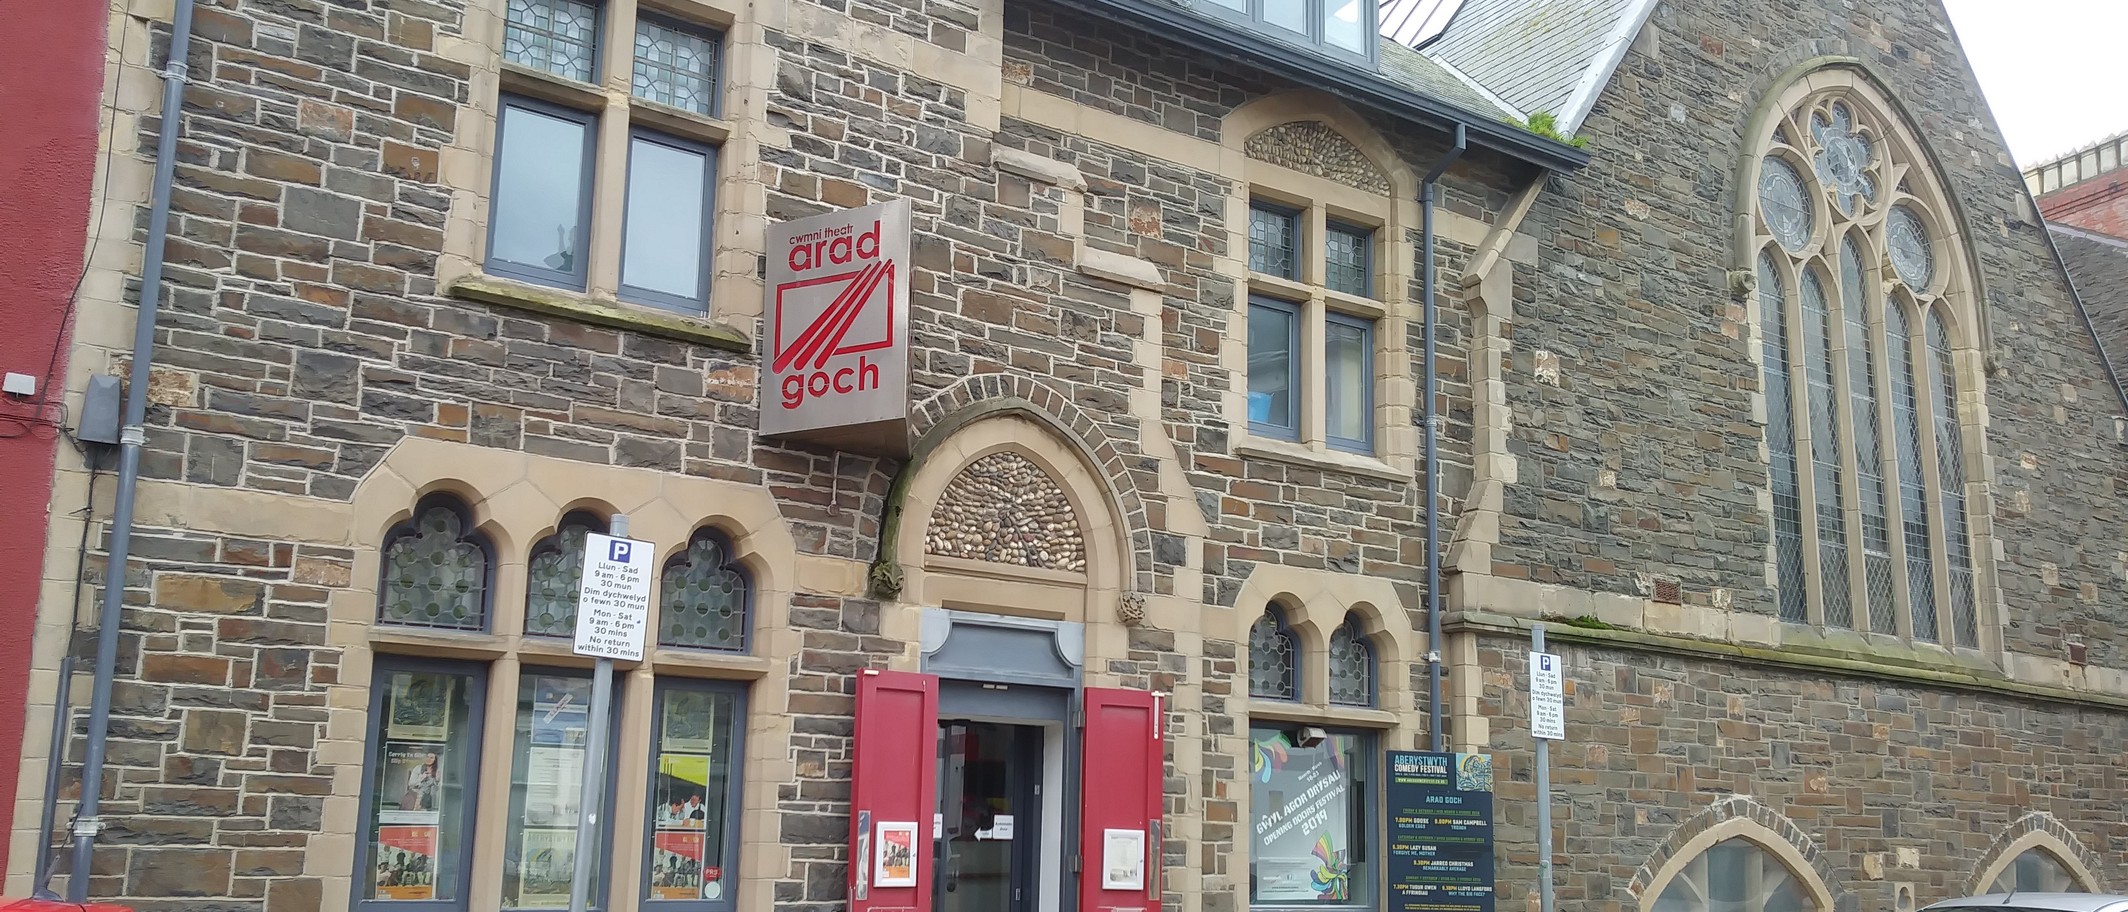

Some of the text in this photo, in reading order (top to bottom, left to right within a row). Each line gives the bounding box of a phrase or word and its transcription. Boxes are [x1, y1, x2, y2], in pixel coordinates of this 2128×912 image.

[789, 223, 854, 245] cwmni theatr
[788, 219, 881, 272] arad
[781, 355, 879, 410] goch
[613, 542, 629, 560] P
[598, 562, 616, 571] Llun
[622, 565, 639, 574] Sad
[600, 579, 632, 591] 30 mun
[584, 586, 647, 602] Dim dychwelyd
[591, 596, 611, 606] fewn
[613, 599, 626, 608] 30
[627, 603, 645, 611] mun
[593, 608, 611, 617] Mon
[618, 612, 633, 621] Sat
[594, 626, 628, 638] 30 mins
[589, 635, 630, 648] No return
[577, 643, 640, 658] within 30 mins
[1542, 656, 1550, 670] P
[1394, 754, 1448, 767] ABERYSTWYTH
[1394, 763, 1448, 774] COMEDY FESTIVAL
[1283, 792, 1308, 817] AGOR
[1306, 769, 1341, 799] DRYSAU
[1425, 795, 1463, 804] ARAD GOCH
[1263, 784, 1346, 846] OPENING DOORS FESTIVAL
[1301, 808, 1328, 836] 2019
